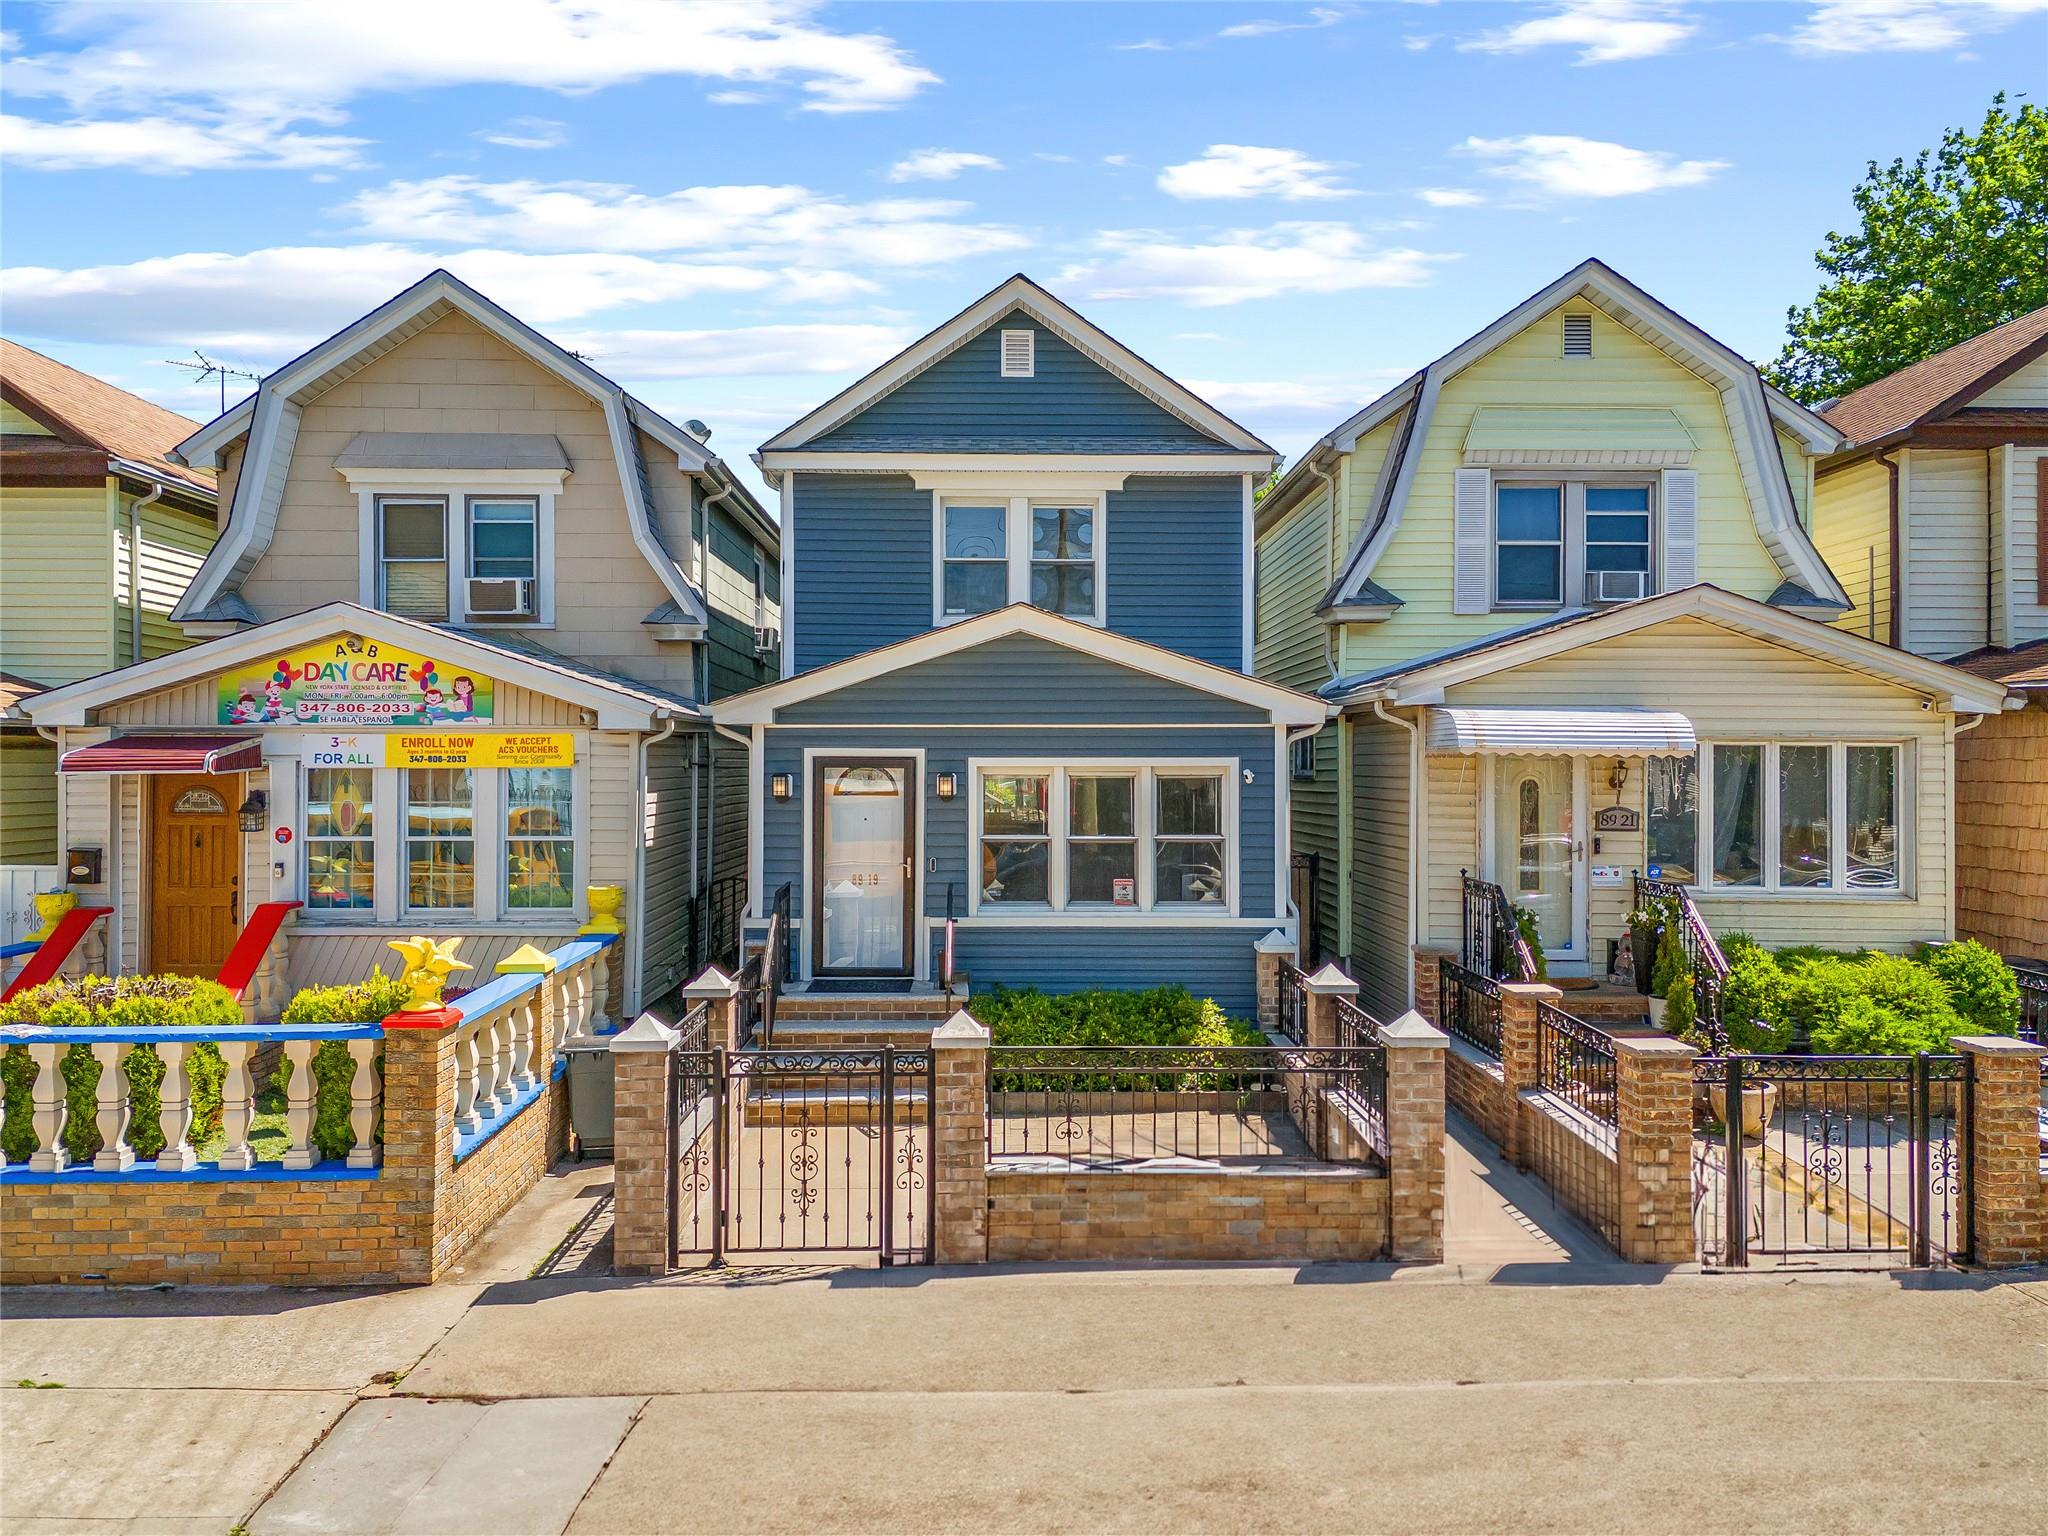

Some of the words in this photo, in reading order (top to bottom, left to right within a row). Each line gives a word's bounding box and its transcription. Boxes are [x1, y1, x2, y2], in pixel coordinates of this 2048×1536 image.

[335, 644, 347, 657] A
[367, 644, 378, 658] B
[303, 661, 348, 682] DAY
[351, 662, 409, 682] CARE
[381, 692, 408, 700] 6:00pm
[299, 703, 411, 713] 347-806-2033
[358, 713, 392, 723] ESPAÑOL
[331, 736, 358, 748] 3-K
[401, 737, 446, 748] ENROLL
[448, 737, 474, 748] NOW
[505, 737, 518, 745] WE
[519, 737, 552, 745] ACCEPT
[498, 746, 515, 754] ACS
[515, 746, 559, 754] VOUCHERS
[314, 753, 343, 764] FOR
[346, 753, 374, 764] ALL
[1601, 814, 1617, 826] 89
[1620, 814, 1636, 826] 21
[868, 873, 879, 886] 19
